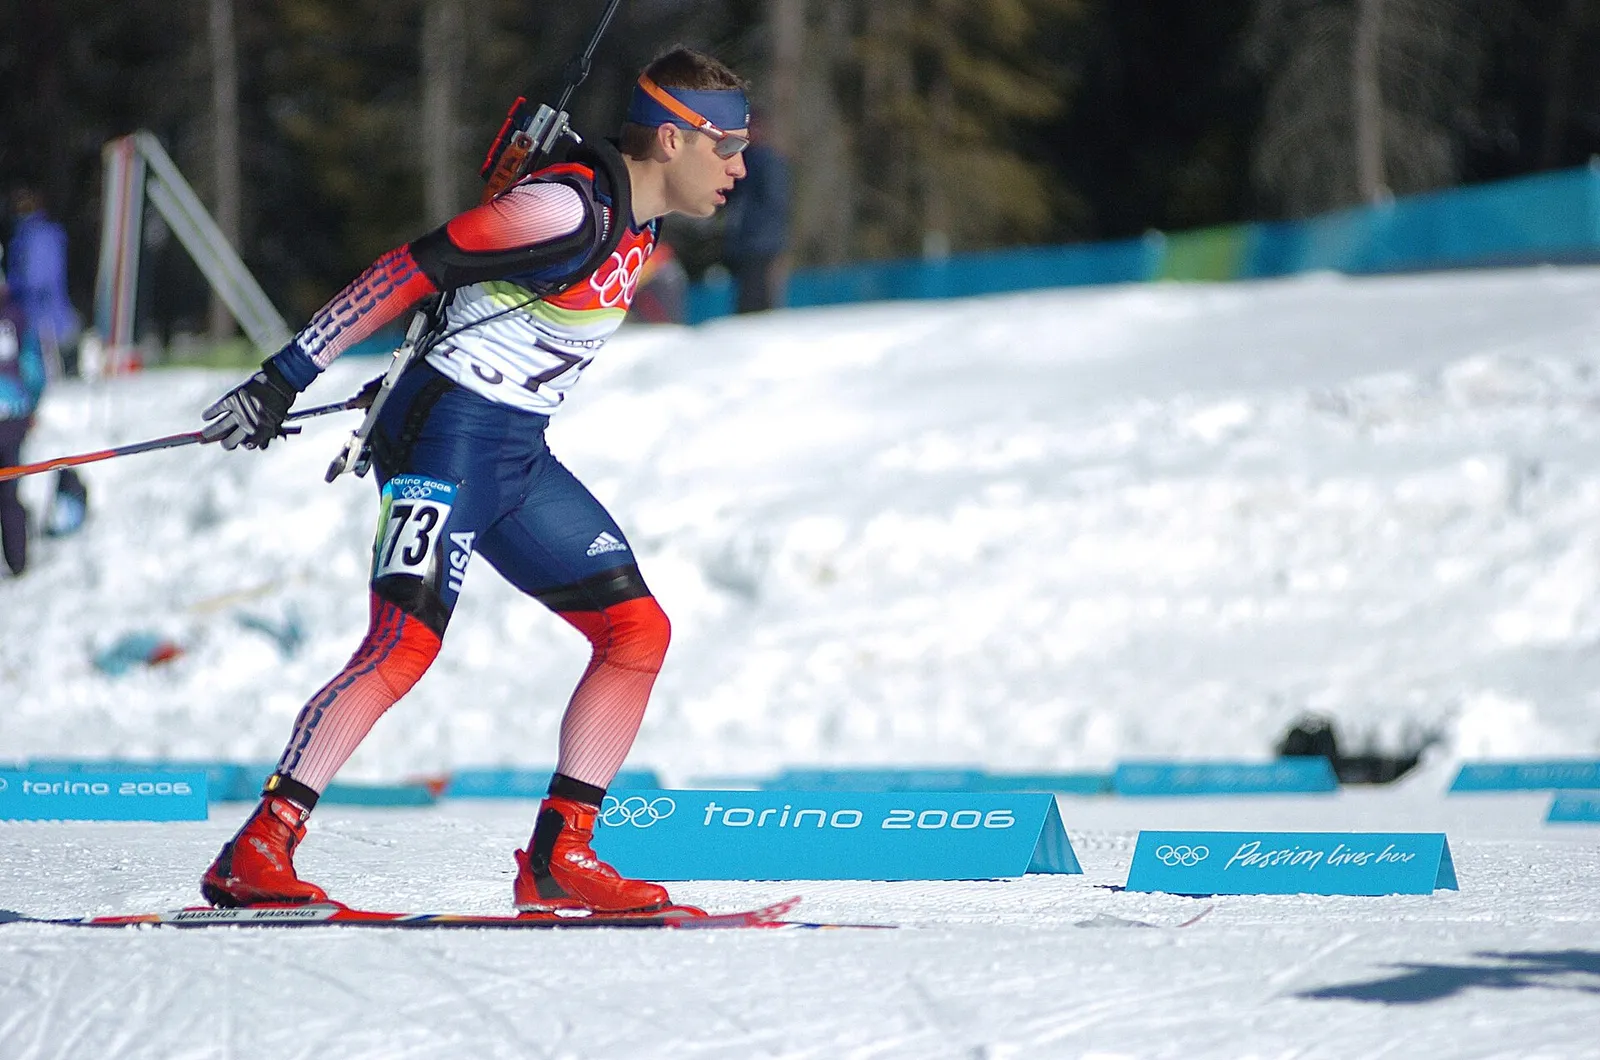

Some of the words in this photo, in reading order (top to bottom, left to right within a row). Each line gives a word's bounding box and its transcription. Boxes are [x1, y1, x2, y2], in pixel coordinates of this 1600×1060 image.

[391, 477, 421, 486] torino
[423, 480, 452, 493] 2006
[383, 504, 440, 567] 73
[586, 542, 628, 557] adidas
[448, 531, 475, 593] USA
[22, 779, 110, 796] torino
[118, 781, 192, 797] 2006
[703, 801, 863, 830] torino
[881, 808, 1016, 830] 2006
[1223, 841, 1324, 871] Passion
[1326, 843, 1375, 867] lives
[1374, 843, 1416, 864] here
[172, 910, 240, 921] MADSHUS
[251, 910, 319, 920] MADSHUS
